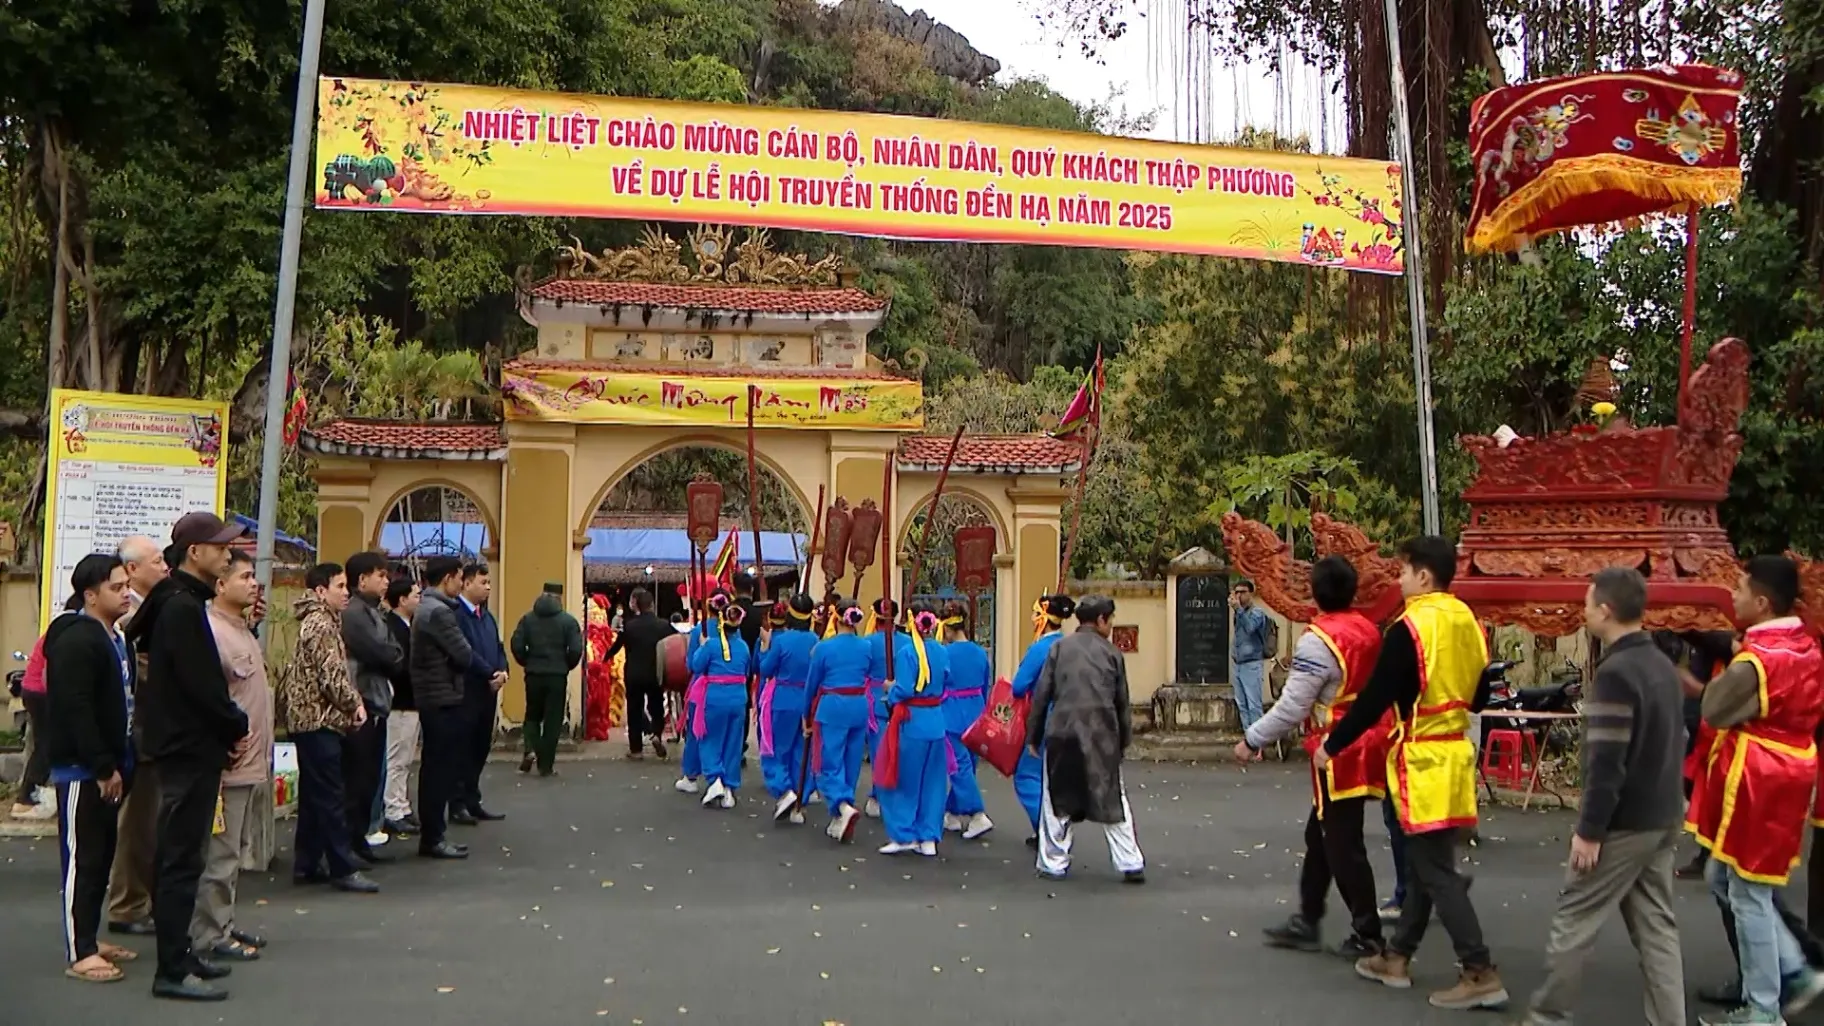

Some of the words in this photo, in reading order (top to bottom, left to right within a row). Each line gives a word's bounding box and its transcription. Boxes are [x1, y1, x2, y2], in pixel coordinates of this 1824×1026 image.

[464, 109, 541, 146] NHIỆT
[548, 113, 600, 149] LIỆT
[608, 116, 675, 151] CHÀO
[684, 119, 759, 155] MỪNG
[767, 124, 818, 159] CÁN
[826, 131, 866, 168] BỘ,
[874, 134, 941, 168] NHÂN
[948, 138, 1003, 174] DÂN,
[1011, 147, 1055, 178] QUÝ
[1063, 151, 1138, 184] KHÁCH
[1146, 158, 1200, 193] THẬP
[1208, 165, 1294, 198] PHƯƠNG
[612, 158, 642, 195] VỀ
[651, 168, 688, 203] DỰ
[693, 161, 720, 201] LỄ
[729, 170, 770, 207] HỘI
[778, 173, 872, 210] TRUYỀN
[880, 176, 958, 215] THỐNG
[965, 184, 1013, 219] ĐỀN
[1020, 194, 1051, 228] HẠ
[1058, 194, 1111, 226] NĂM
[1118, 202, 1172, 231] 2025
